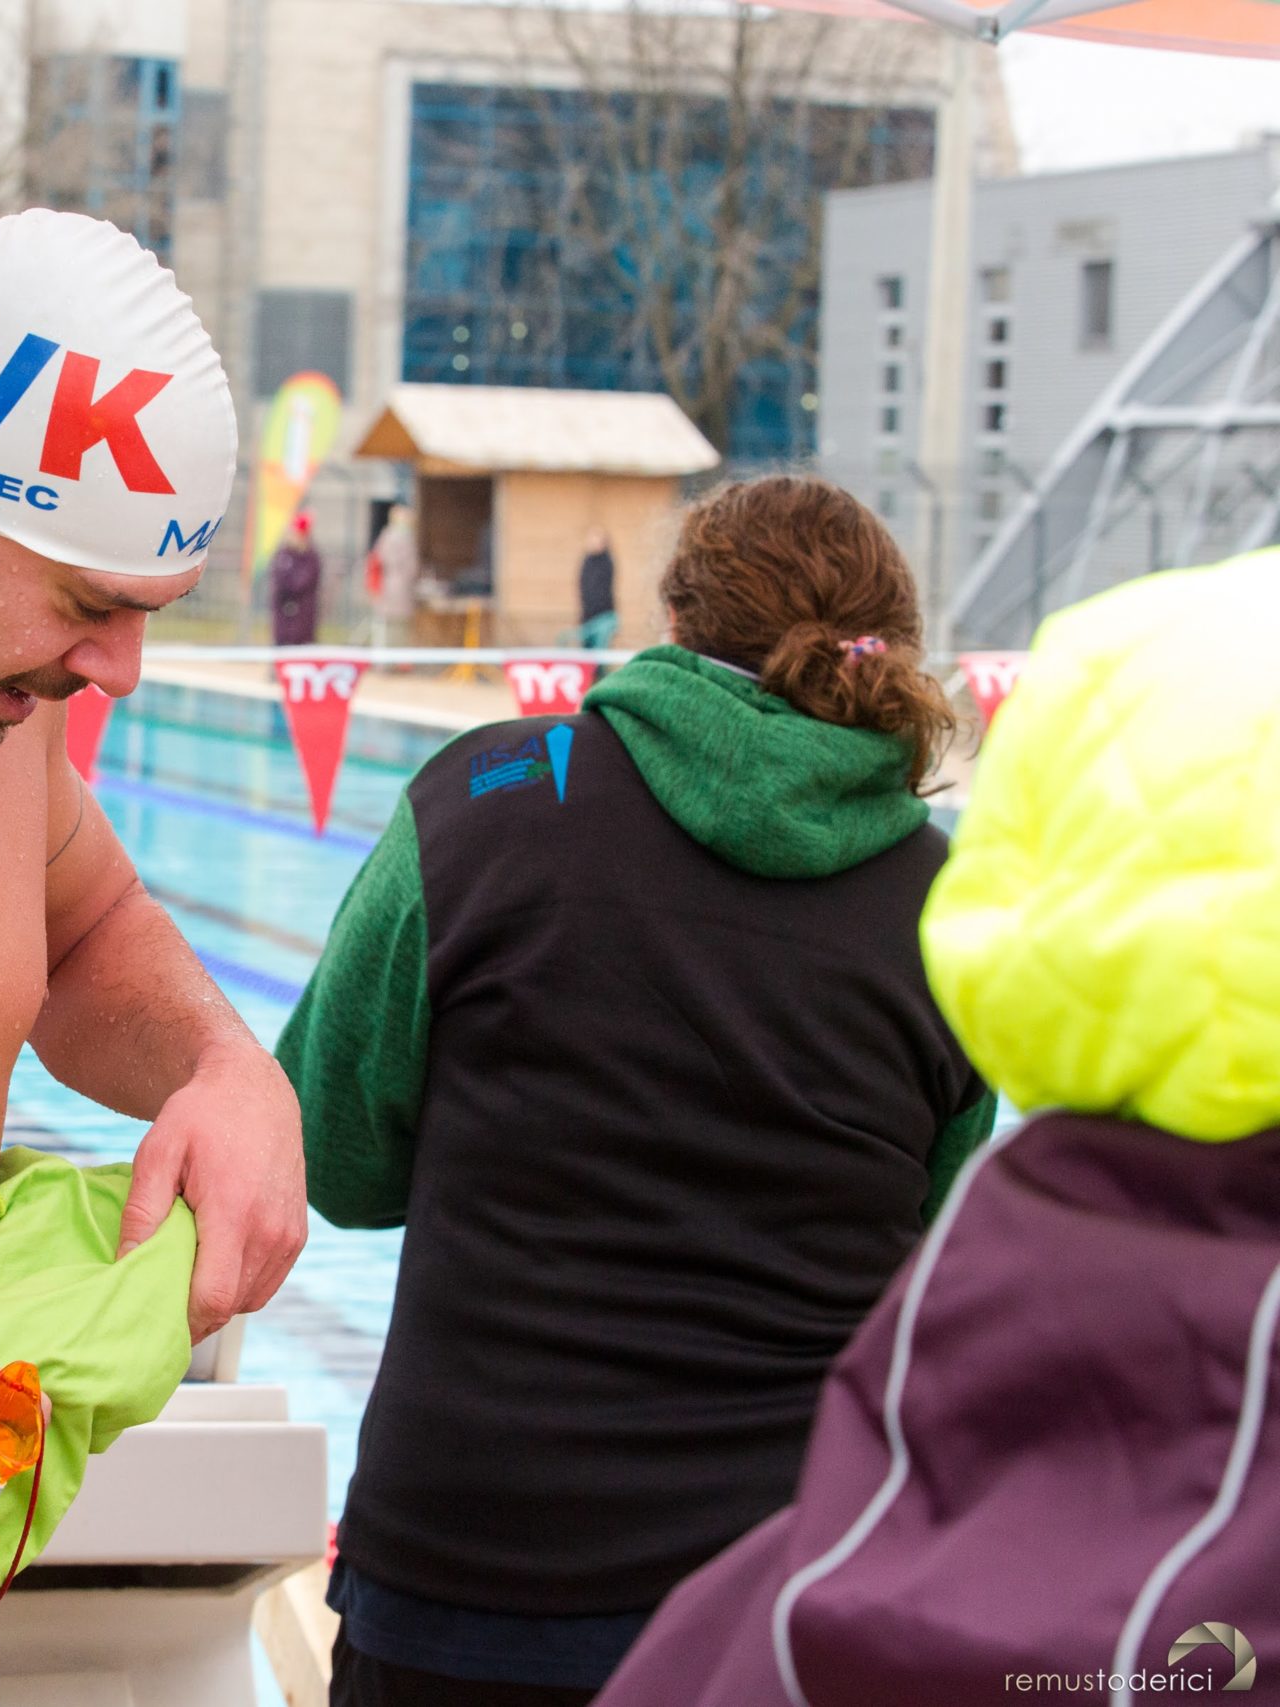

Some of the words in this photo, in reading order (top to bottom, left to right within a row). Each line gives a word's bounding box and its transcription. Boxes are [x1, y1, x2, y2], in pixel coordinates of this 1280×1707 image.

[281, 662, 359, 703] TYR
[508, 663, 586, 704] TYR
[968, 662, 1023, 698] TY
